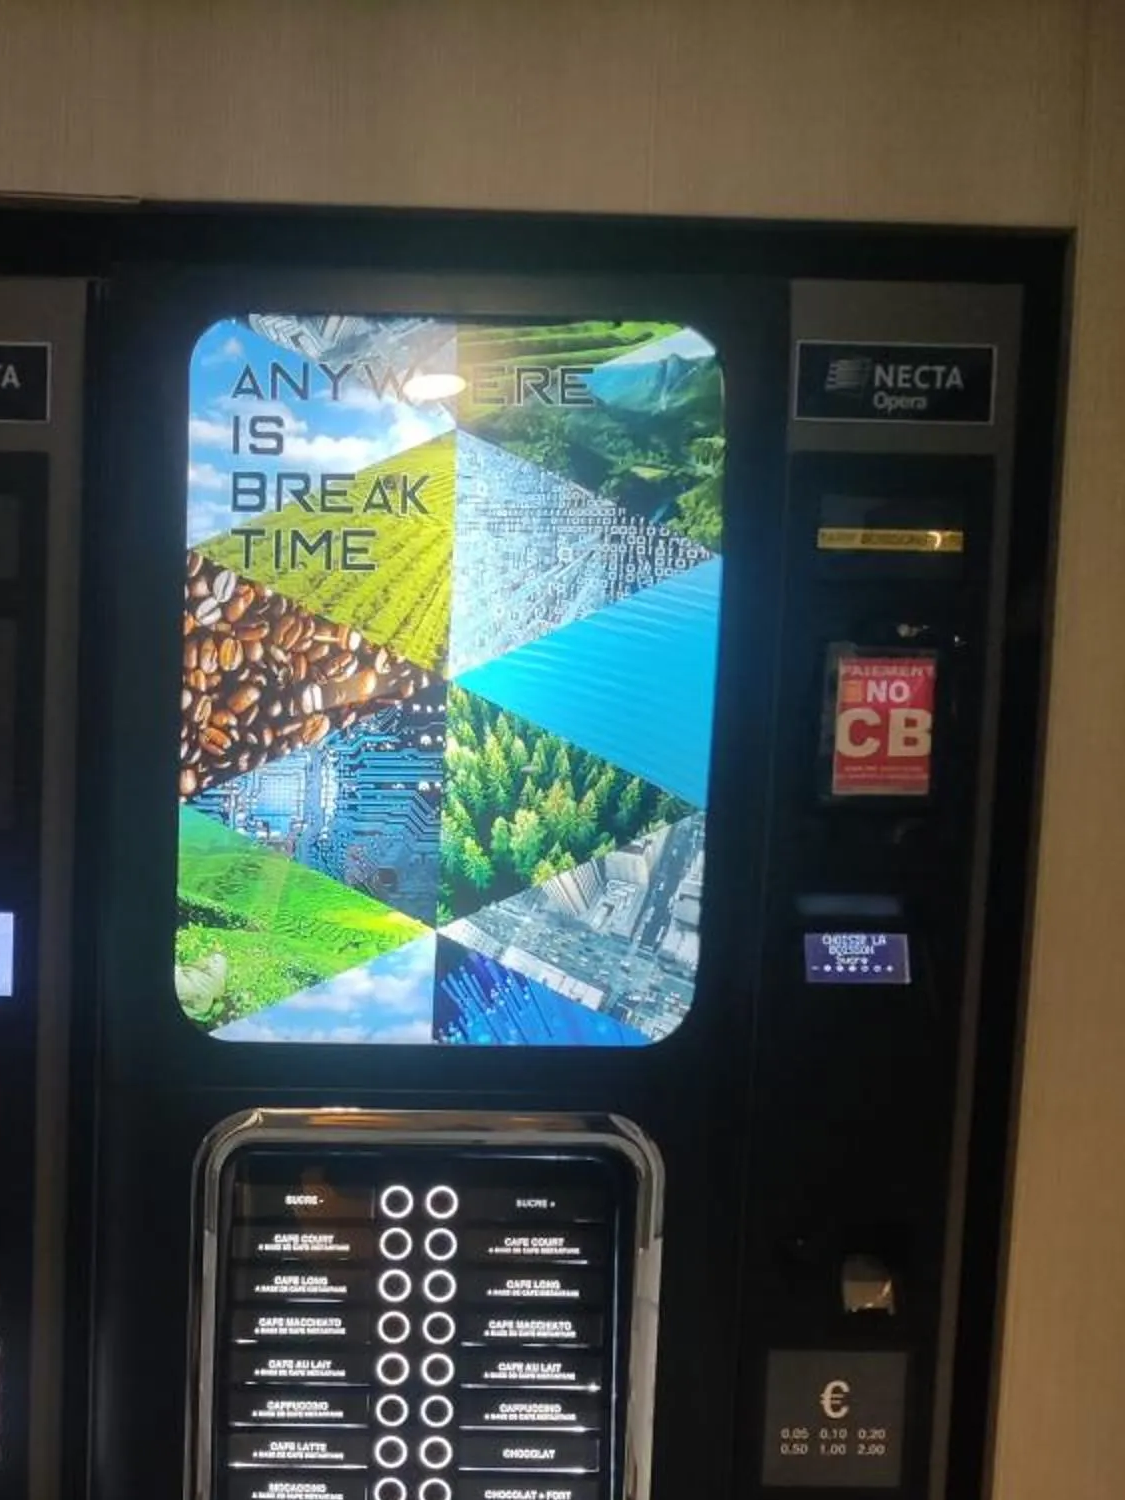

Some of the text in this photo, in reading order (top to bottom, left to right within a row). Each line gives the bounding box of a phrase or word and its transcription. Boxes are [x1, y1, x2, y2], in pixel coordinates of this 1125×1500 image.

[231, 361, 595, 406] ANYWERE
[874, 363, 965, 390] NECTA
[873, 390, 928, 413] Opera
[231, 415, 284, 455] IS
[231, 471, 430, 516] BREAK
[231, 528, 377, 572] TIME
[835, 707, 933, 758] CB
[819, 1379, 850, 1419] €
[819, 1427, 848, 1440] 0.10
[819, 1443, 847, 1456] 1.00
[857, 1443, 886, 1456] 2.00
